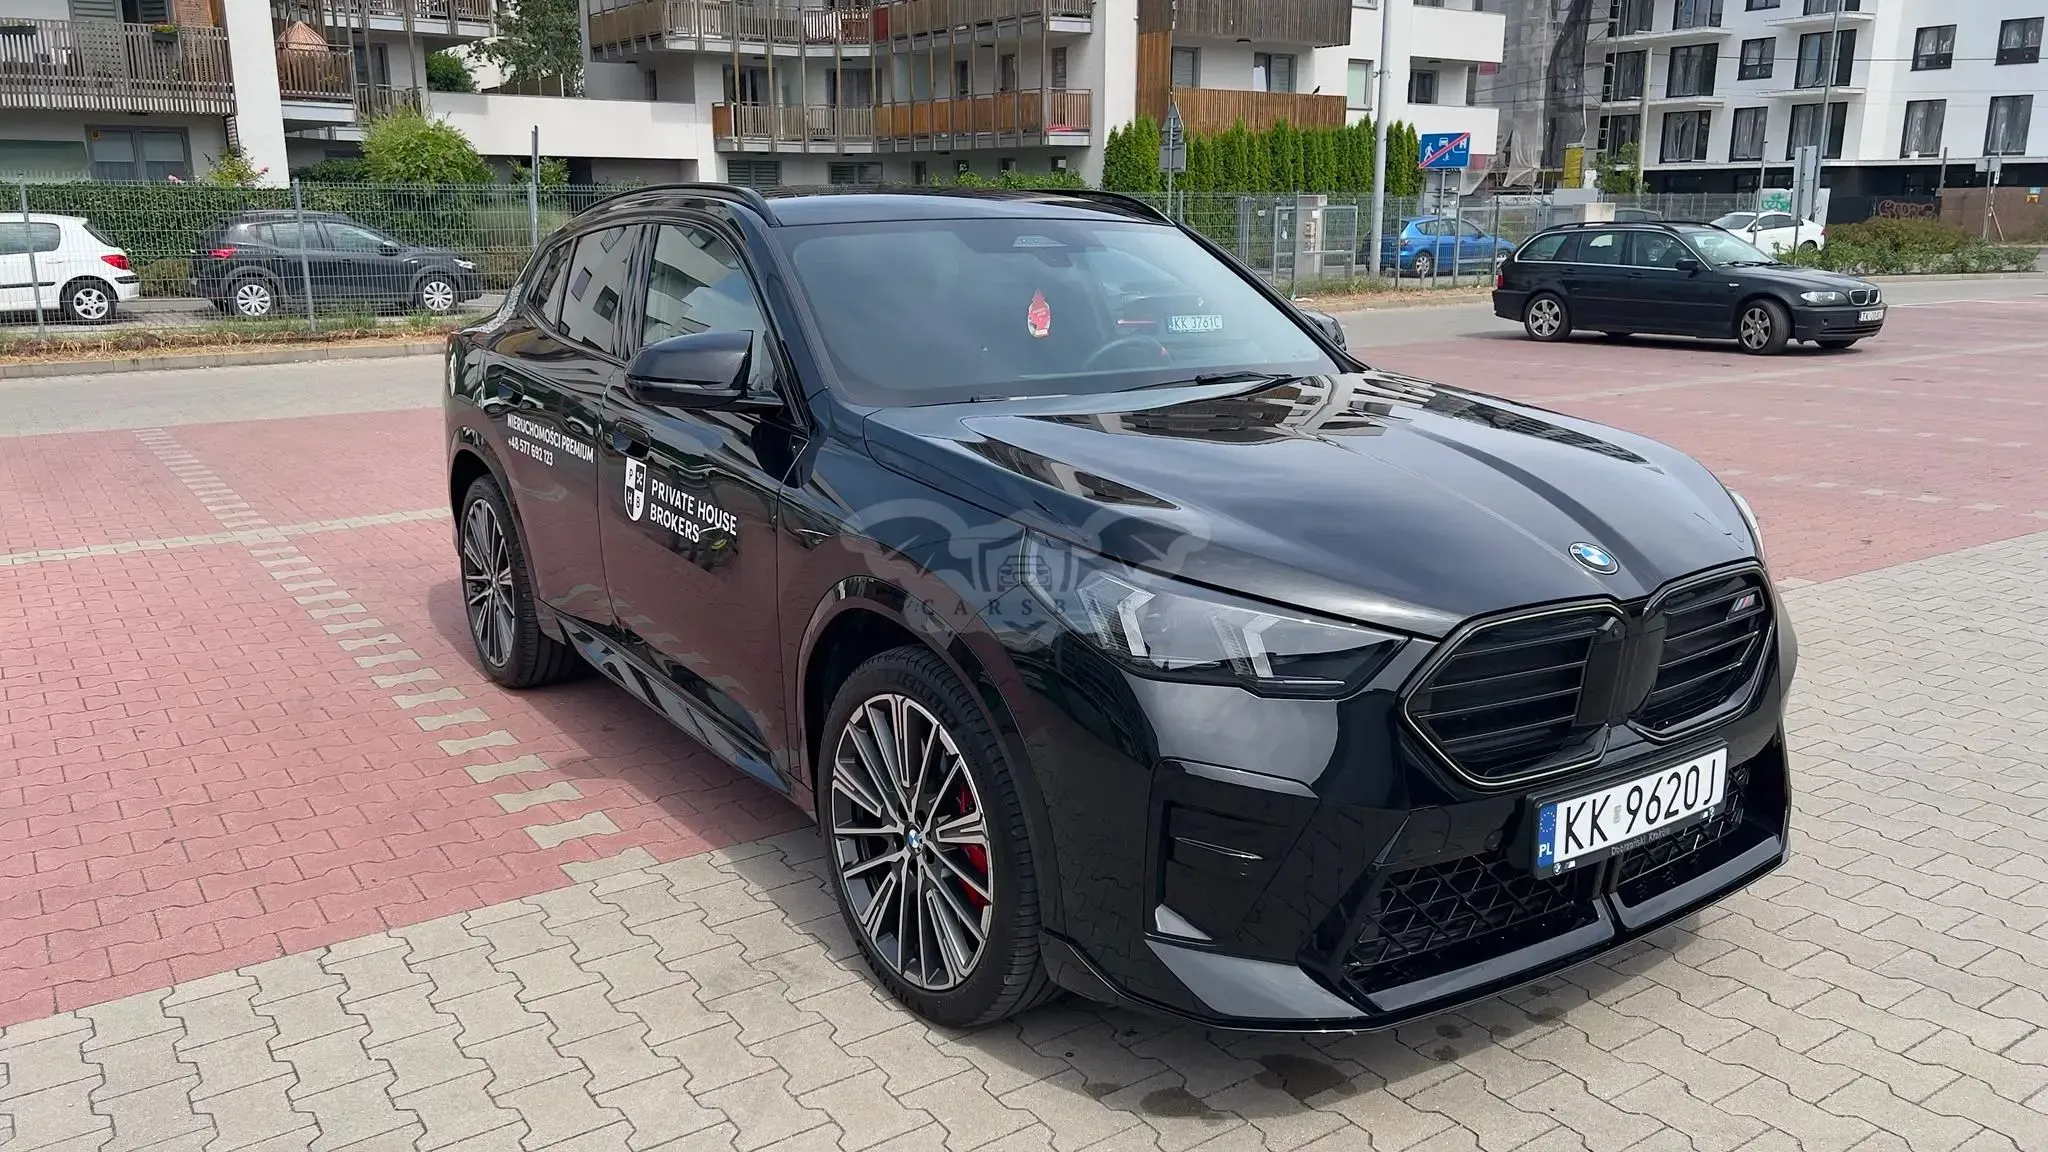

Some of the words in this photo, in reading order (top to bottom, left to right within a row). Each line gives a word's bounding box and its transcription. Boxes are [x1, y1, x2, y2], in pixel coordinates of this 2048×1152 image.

[1174, 317, 1187, 329] KK
[507, 413, 561, 448] NIERUCHOMOŚCI
[561, 434, 594, 463] PREMIUM
[507, 436, 519, 450] +48
[520, 438, 531, 455] 577
[531, 444, 543, 461] 692
[543, 449, 553, 466] 123
[627, 491, 633, 505] H
[651, 479, 695, 515] PRIVATE
[697, 500, 737, 536] HOUSE
[649, 502, 700, 543] BROKERS
[1564, 794, 1611, 854] KK
[1625, 759, 1716, 835] 9620J
[1538, 843, 1553, 858] PL
